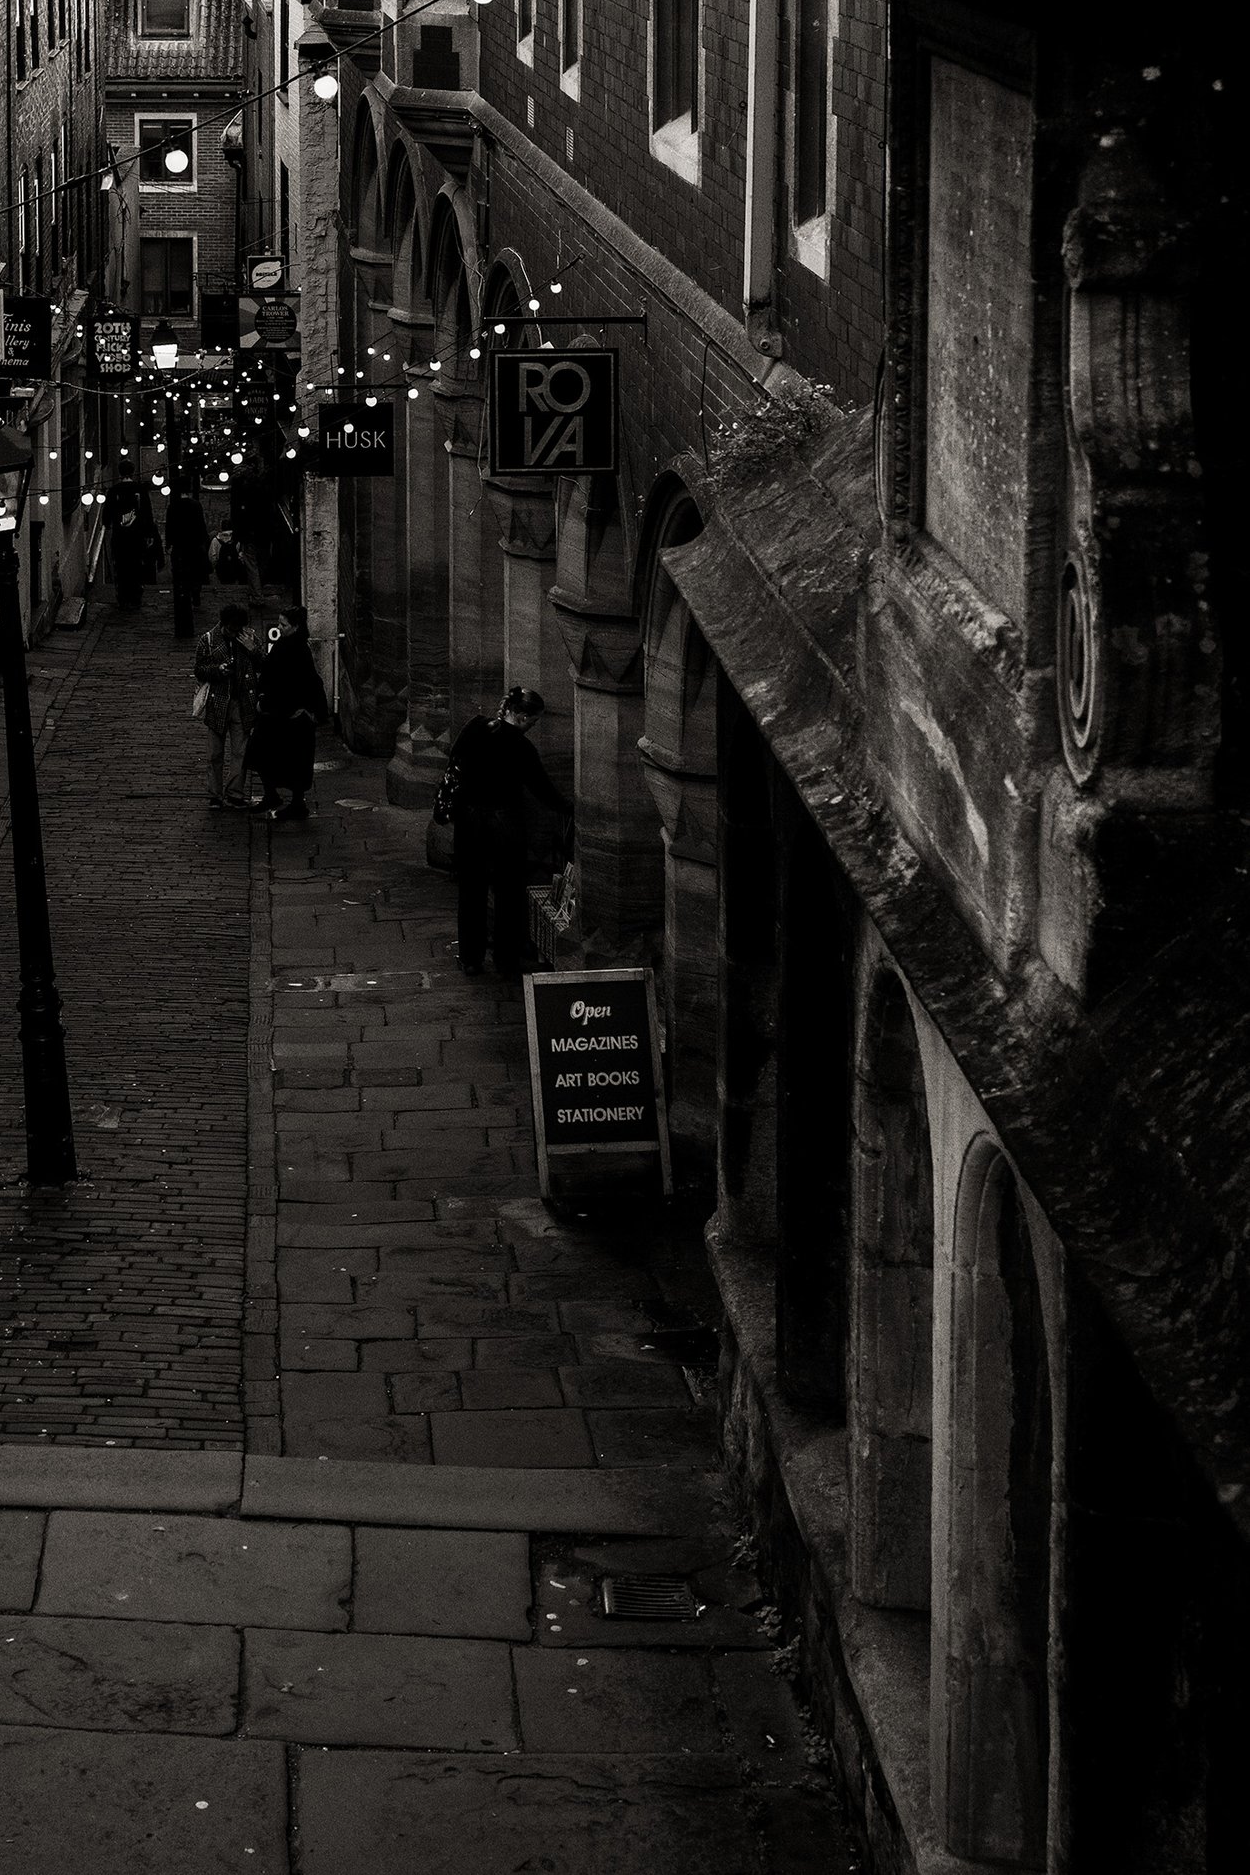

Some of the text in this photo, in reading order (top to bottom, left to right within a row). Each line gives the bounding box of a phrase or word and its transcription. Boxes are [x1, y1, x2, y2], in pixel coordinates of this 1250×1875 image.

[94, 322, 131, 335] 20TH
[4, 335, 30, 350] llery
[100, 363, 131, 373] SHOP
[519, 361, 591, 413] RO
[326, 430, 386, 449] HUSK
[524, 416, 584, 466] VA
[569, 1000, 612, 1025] Open
[551, 1035, 639, 1052] MAGAZINES
[555, 1071, 640, 1088] ART BOOKS
[557, 1106, 645, 1124] STATIONERY
